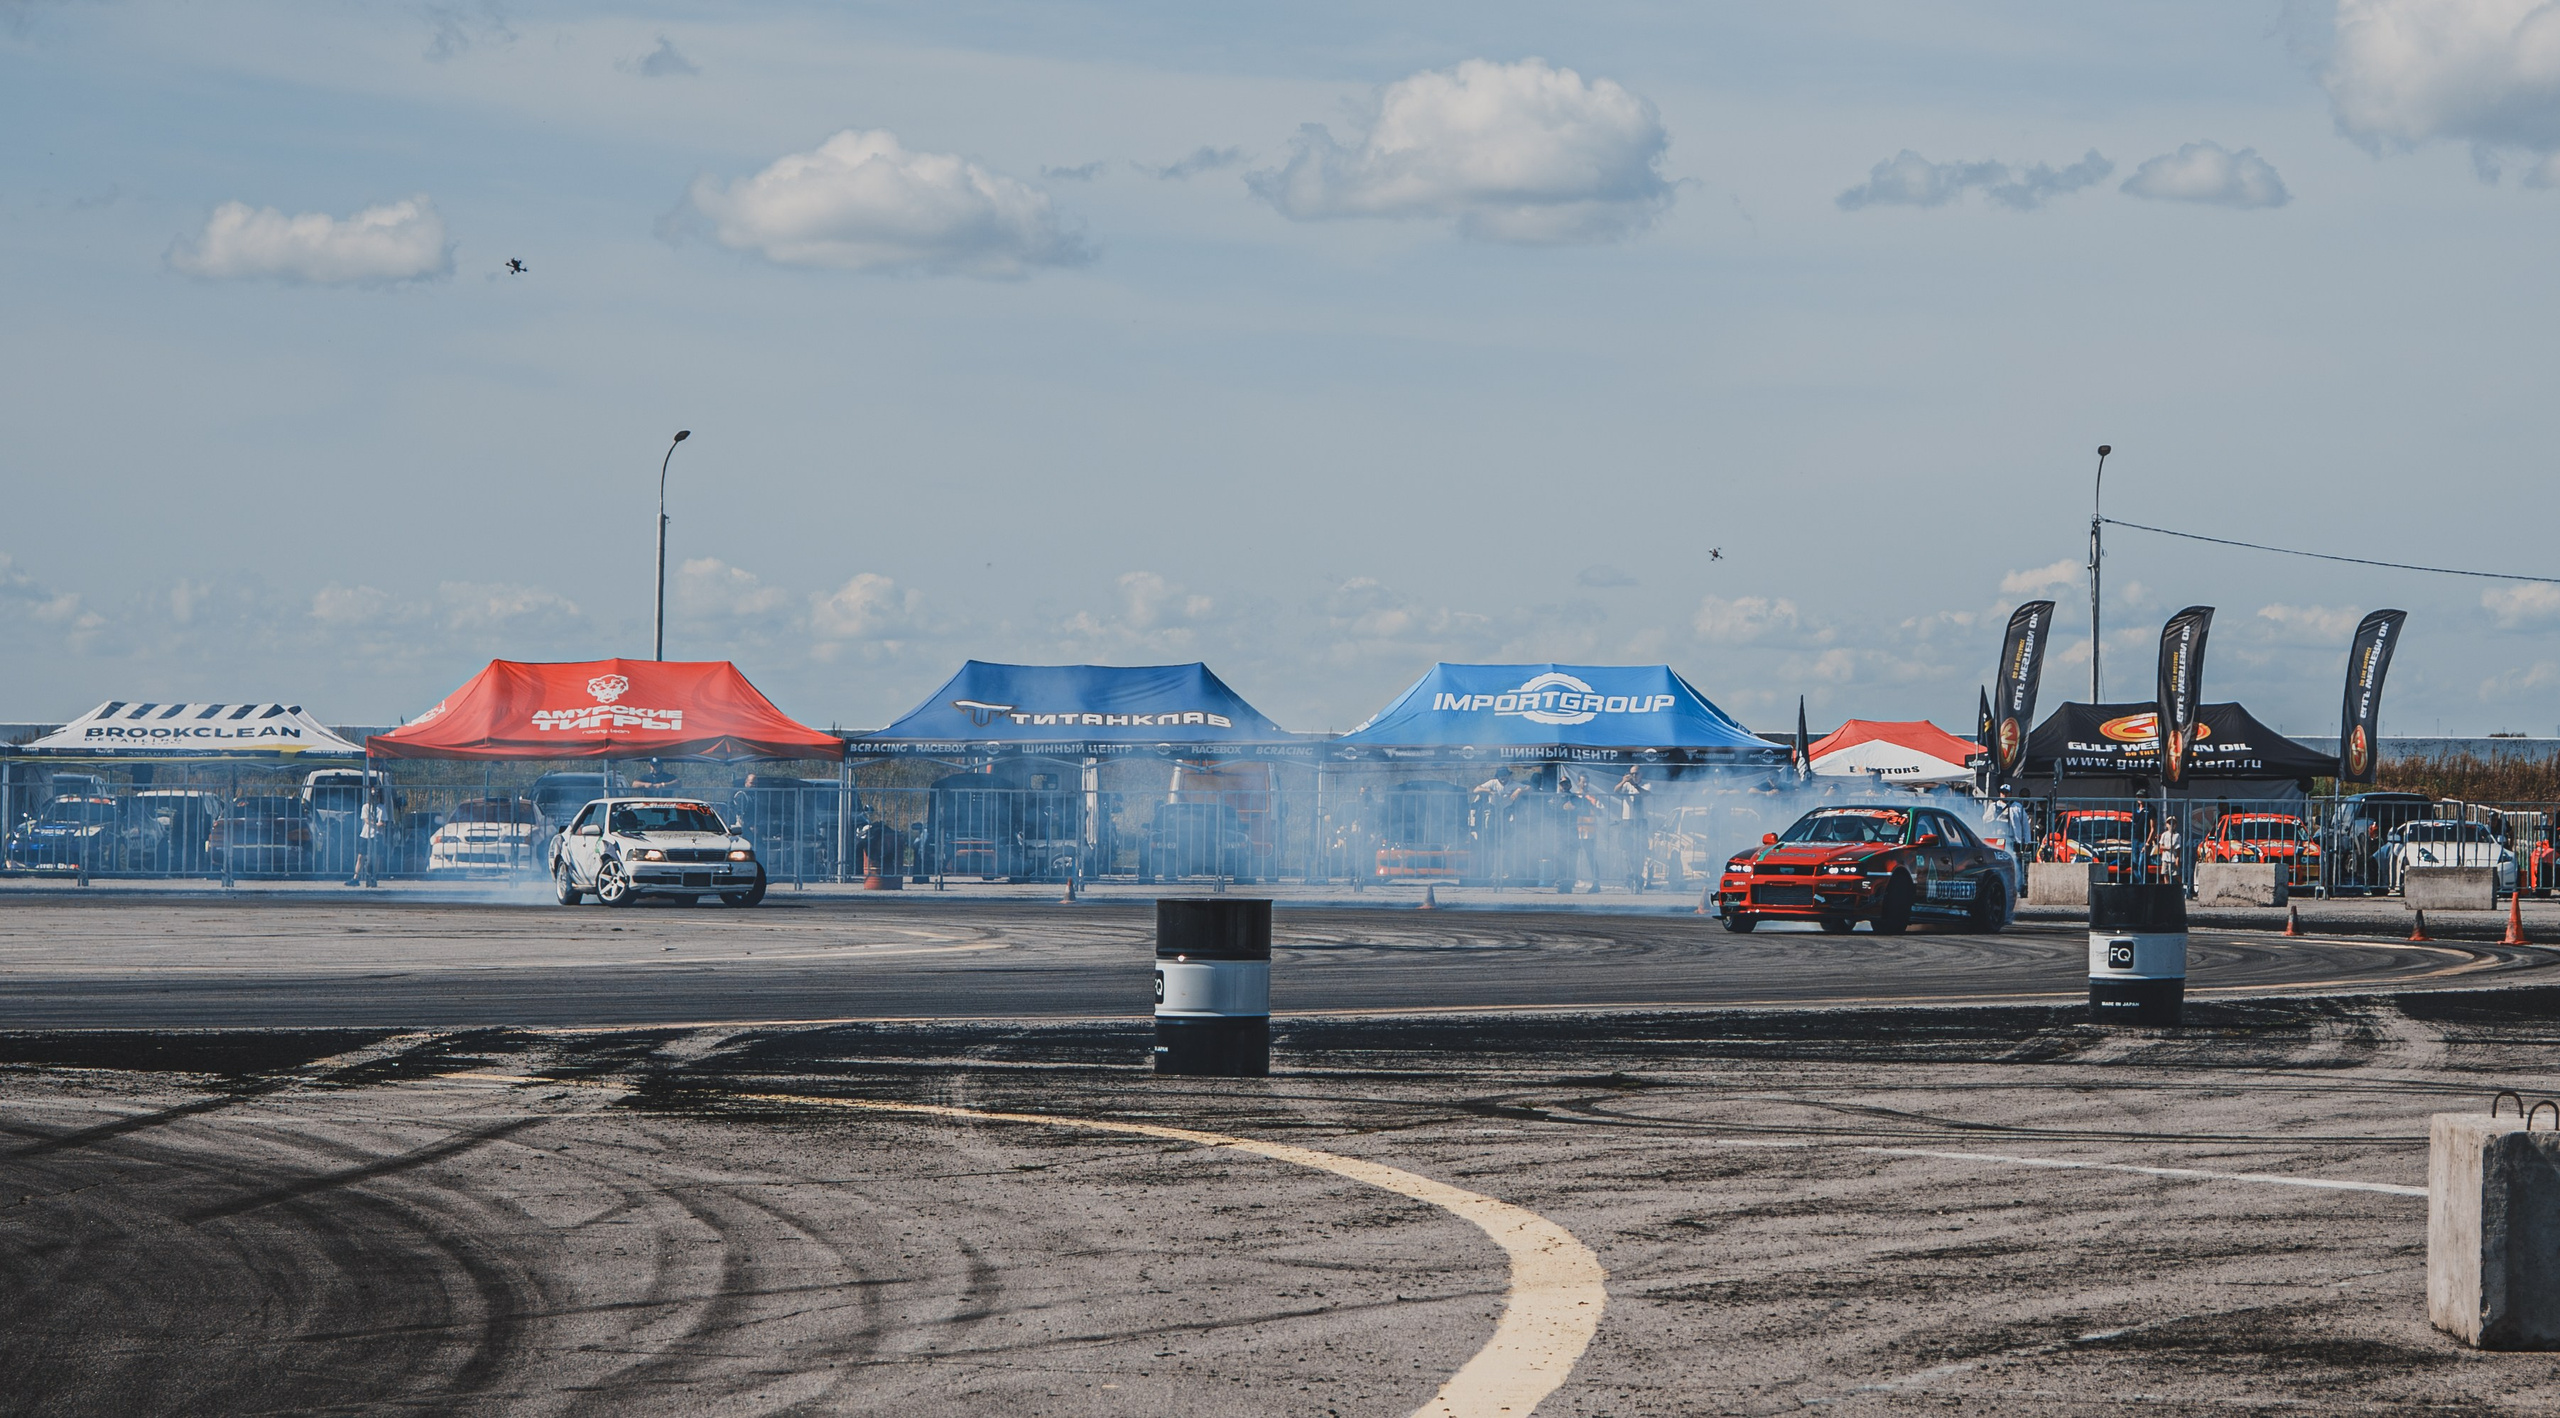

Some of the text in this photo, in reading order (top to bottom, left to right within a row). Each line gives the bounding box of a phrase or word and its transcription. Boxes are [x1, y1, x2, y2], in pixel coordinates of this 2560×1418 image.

[1432, 691, 1676, 713] IMPORTGROUP
[532, 705, 682, 720] АМУРСКИЕ
[1009, 711, 1233, 728] ТИТАНКЛАВ
[532, 715, 682, 731] ТИГРЫ
[85, 725, 301, 739] BROOKCLEAN
[850, 742, 909, 753] BCRACING
[915, 742, 967, 754] RACEBOX
[1021, 741, 1133, 757] ШИННЫЙ ЦЕНТР
[1190, 745, 1242, 756] RACEBOX
[1255, 746, 1314, 757] BCRACING
[1500, 745, 1619, 761] ШИННЫЙ ЦЕНТР
[2067, 741, 2118, 753] GULF
[2218, 742, 2254, 752] OIL
[1926, 879, 1977, 900] MOLYGREEN
[2110, 948, 2131, 961] FQ
